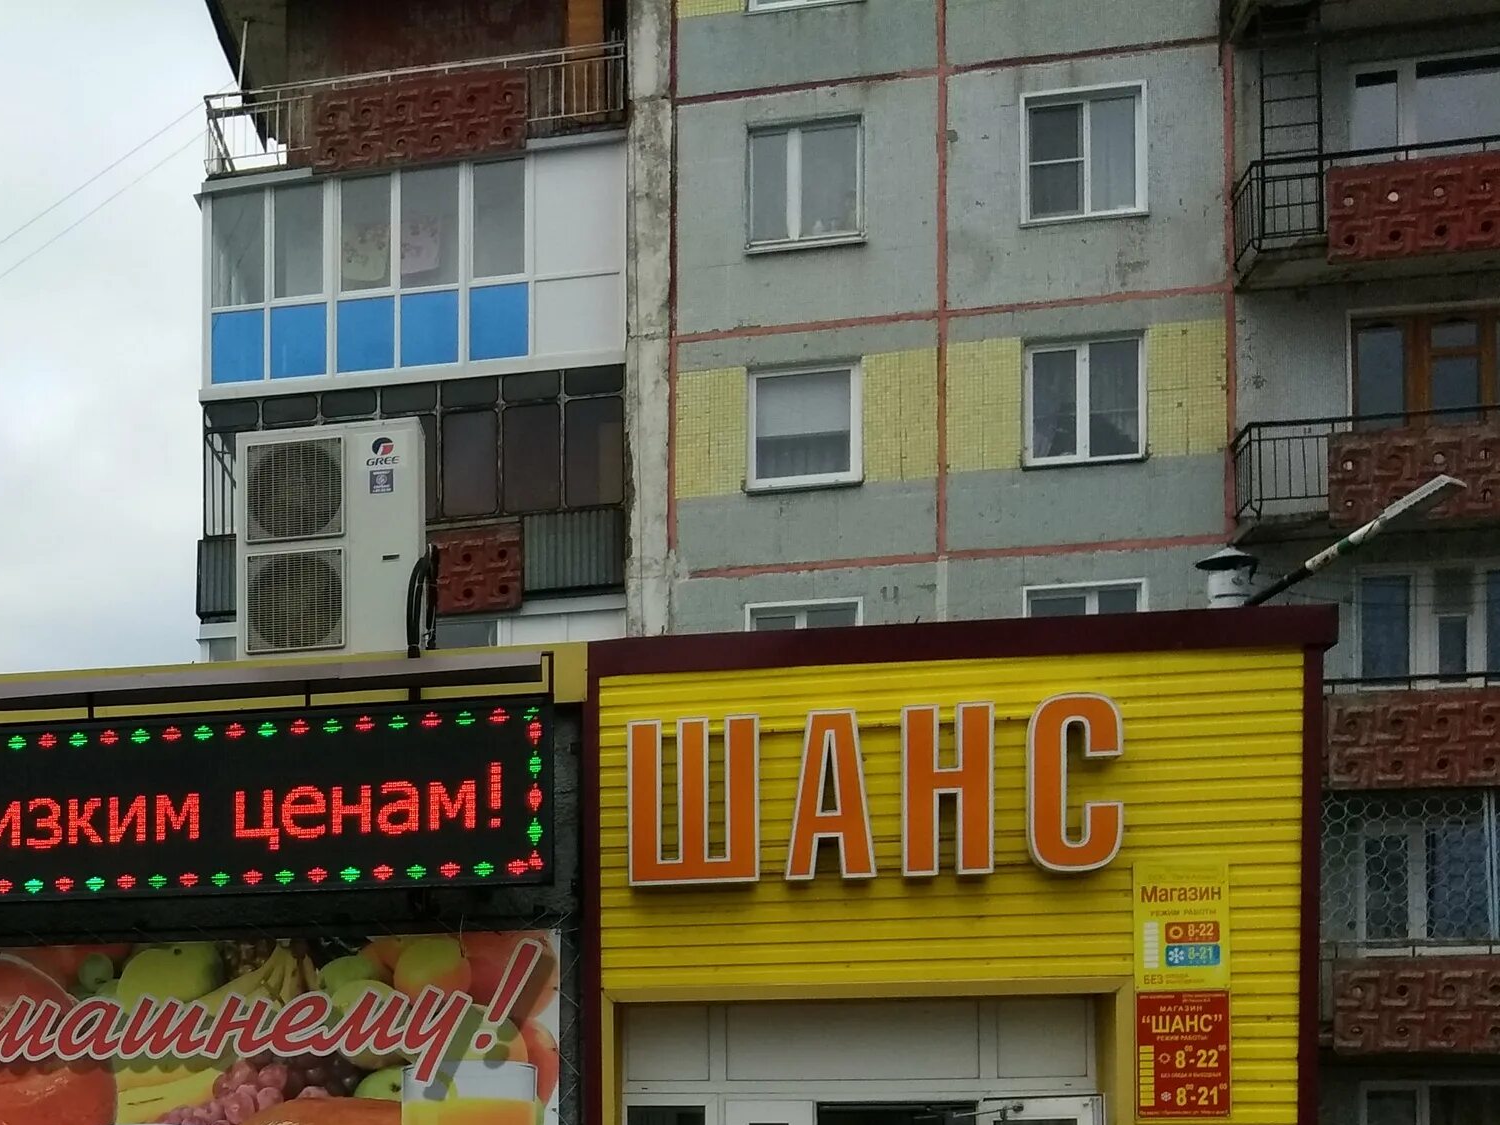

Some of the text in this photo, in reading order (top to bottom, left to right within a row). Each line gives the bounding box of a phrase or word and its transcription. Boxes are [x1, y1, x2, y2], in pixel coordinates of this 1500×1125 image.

[366, 456, 400, 466] GREE
[234, 761, 503, 850] ценам!
[625, 692, 1124, 887] ШАНС
[1141, 886, 1221, 902] Магазин
